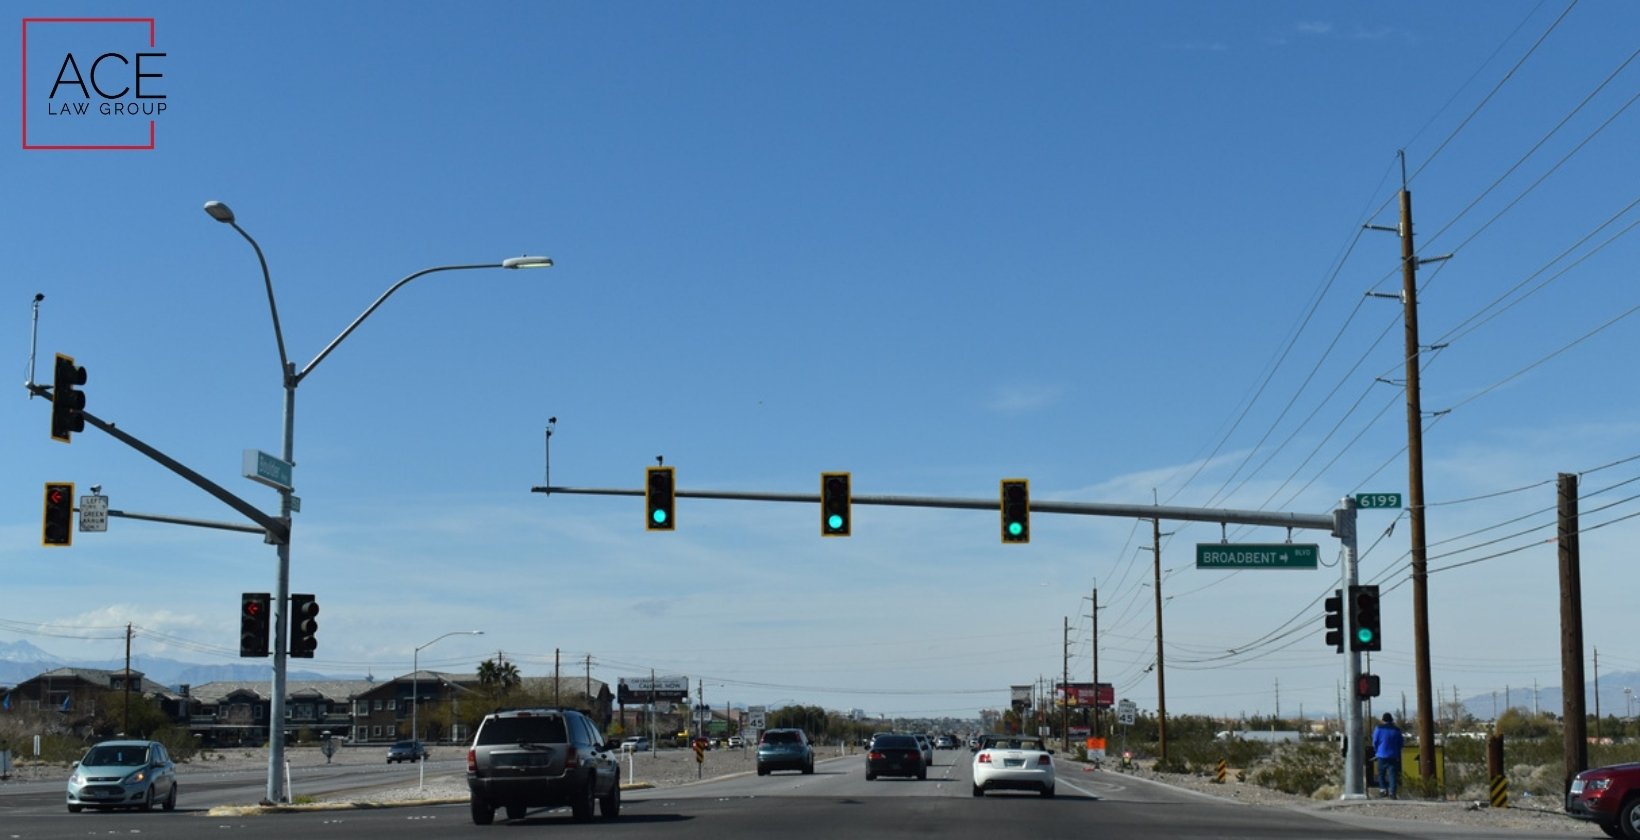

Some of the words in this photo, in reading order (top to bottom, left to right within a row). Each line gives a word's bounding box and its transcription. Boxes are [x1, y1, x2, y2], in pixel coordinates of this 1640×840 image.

[1360, 495, 1398, 507] 6199
[1203, 552, 1277, 564] BROADBENT
[1294, 549, 1311, 557] BLVD
[1120, 714, 1133, 722] 45
[750, 719, 764, 728] 45
